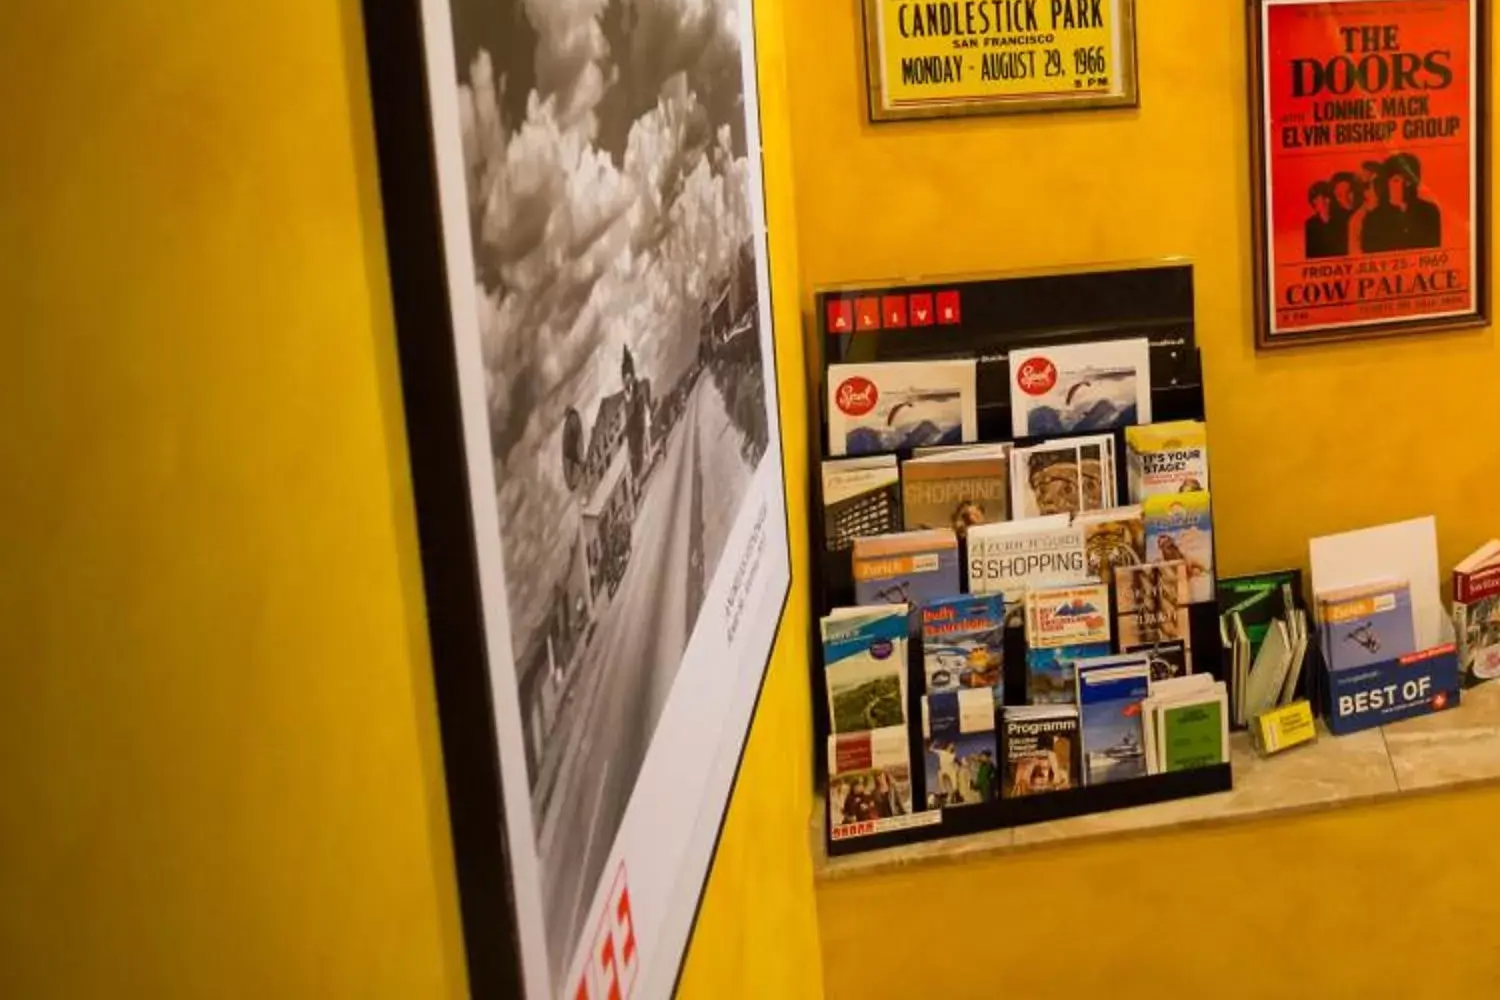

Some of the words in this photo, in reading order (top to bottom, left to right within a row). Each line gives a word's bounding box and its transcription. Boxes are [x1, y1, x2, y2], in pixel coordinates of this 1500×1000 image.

[952, 39, 979, 49] SAN
[983, 34, 1055, 47] FRANCISCO
[1340, 24, 1400, 53] THE
[901, 55, 963, 86] MONDAY
[981, 50, 1036, 81] AUGUST
[1073, 46, 1105, 75] 1966
[1290, 50, 1453, 98] DOORS
[1313, 98, 1377, 122] LONNIE
[1381, 95, 1430, 118] MACK
[1282, 124, 1330, 149] ELVIN
[1335, 120, 1397, 145] BISHOP
[1402, 117, 1461, 140] GROUP
[1286, 278, 1351, 306] COW
[1357, 269, 1461, 299] PALACE
[987, 551, 1083, 579] SHOPPING
[1339, 684, 1397, 717] BEST
[1403, 676, 1431, 700] OF
[1008, 720, 1077, 736] Programm
